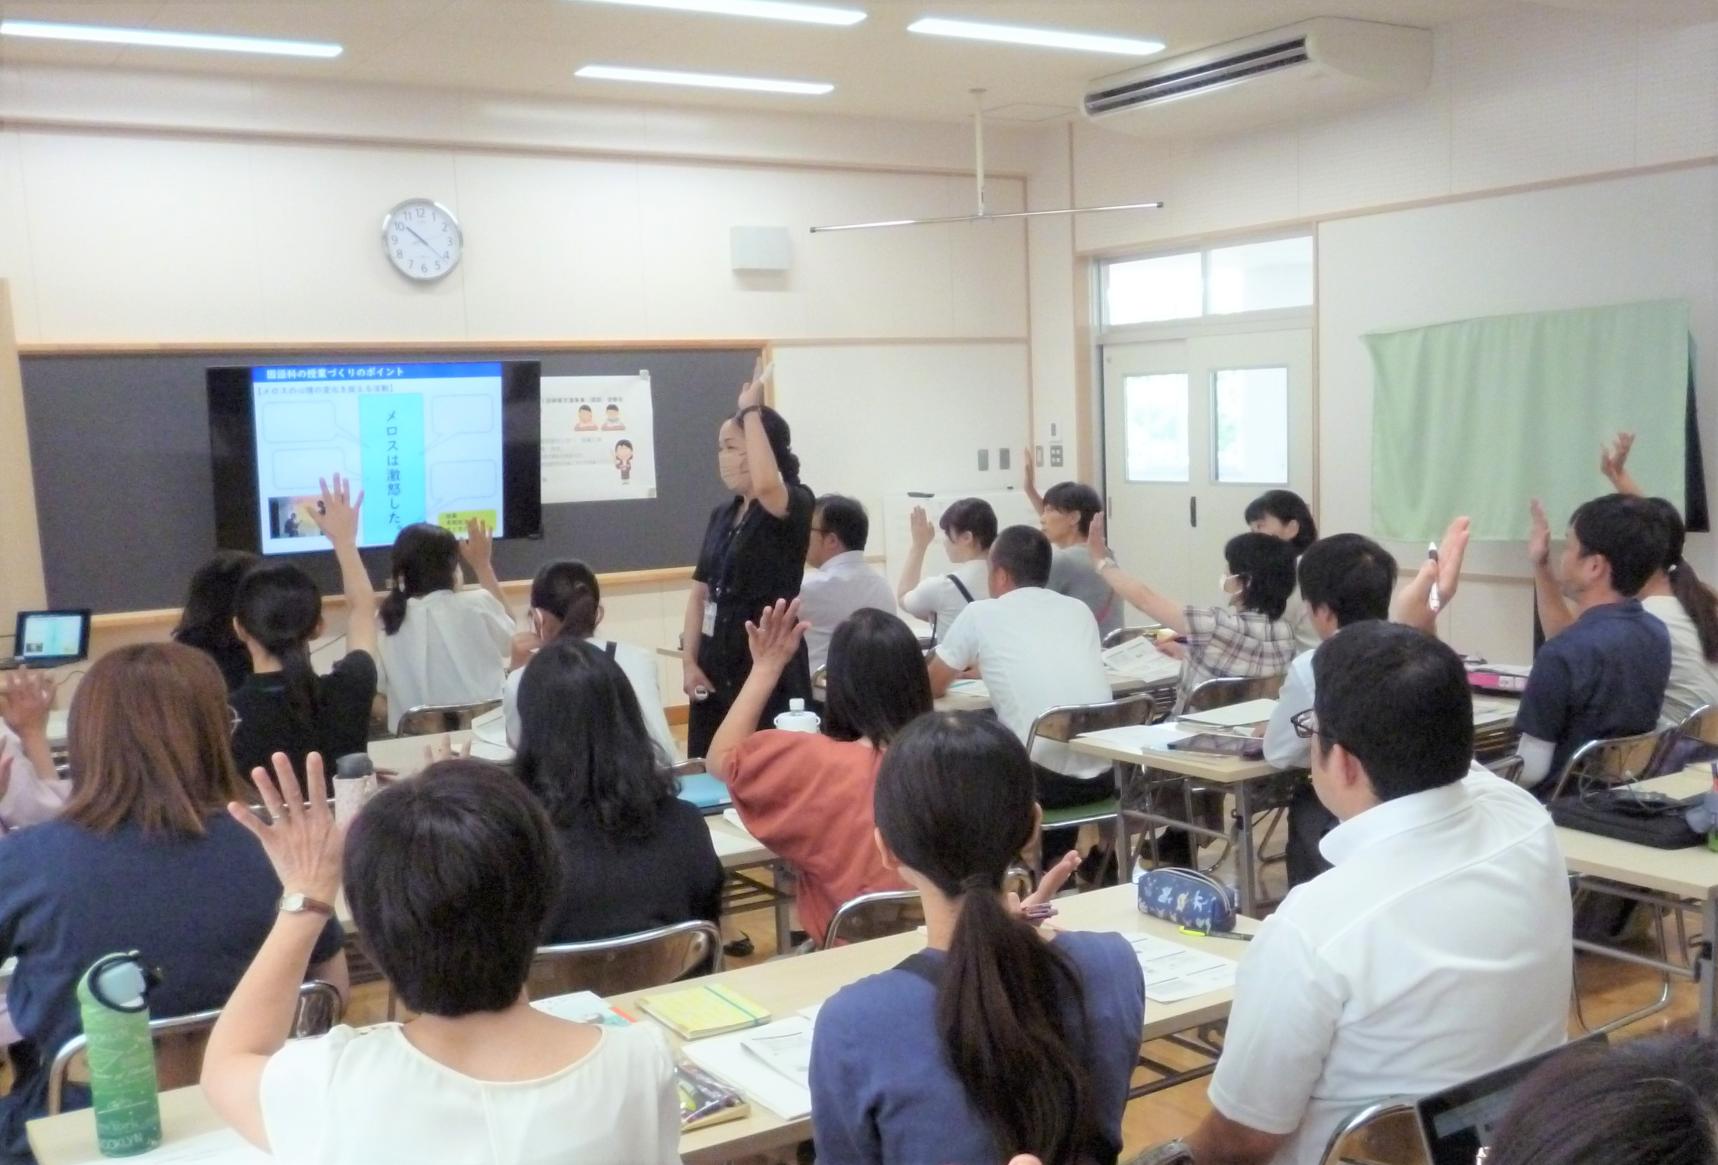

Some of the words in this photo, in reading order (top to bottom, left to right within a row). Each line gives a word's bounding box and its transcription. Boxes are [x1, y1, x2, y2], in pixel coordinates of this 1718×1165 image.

[403, 211, 412, 221] 11
[416, 208, 425, 218] 12
[394, 221, 405, 232] 10
[441, 223, 448, 232] 2
[391, 235, 398, 245] 9
[447, 236, 453, 246] 3
[396, 249, 403, 259] 8
[443, 250, 449, 260] 4
[408, 259, 414, 269] 7
[421, 264, 428, 273] 6
[434, 260, 441, 270] 5
